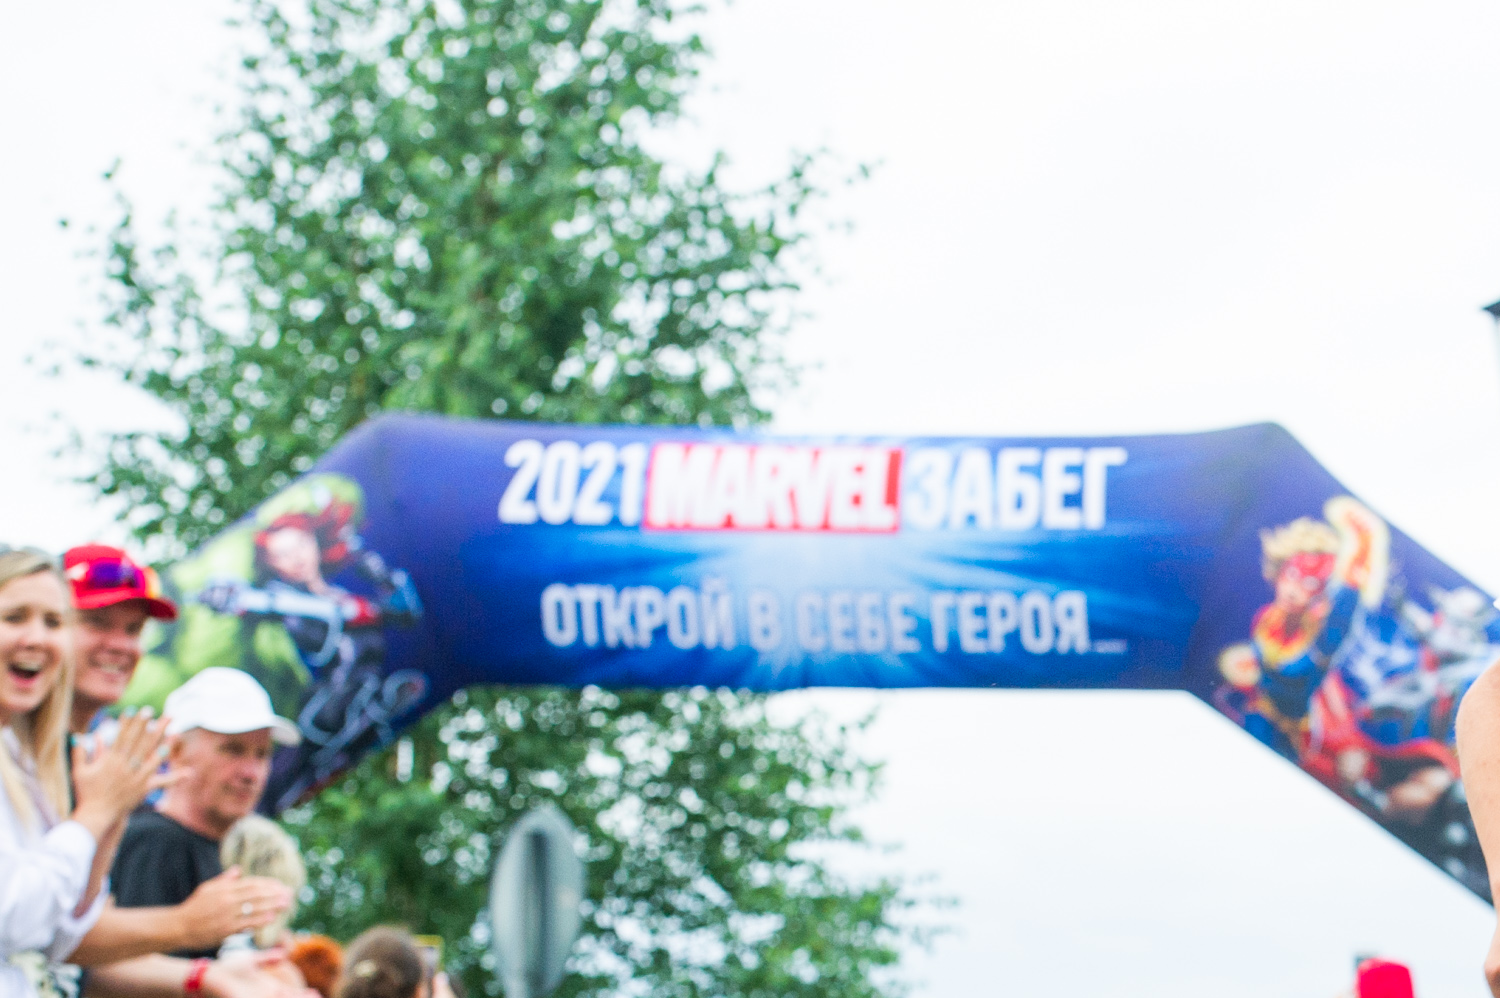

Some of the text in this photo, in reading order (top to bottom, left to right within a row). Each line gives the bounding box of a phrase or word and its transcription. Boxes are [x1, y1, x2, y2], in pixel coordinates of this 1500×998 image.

[498, 439, 1128, 531] 2021 MARVEL ЗАБЕГ
[541, 577, 734, 652] ОТКРОЙ
[747, 590, 783, 652] В
[800, 590, 922, 654] СЕБЕ
